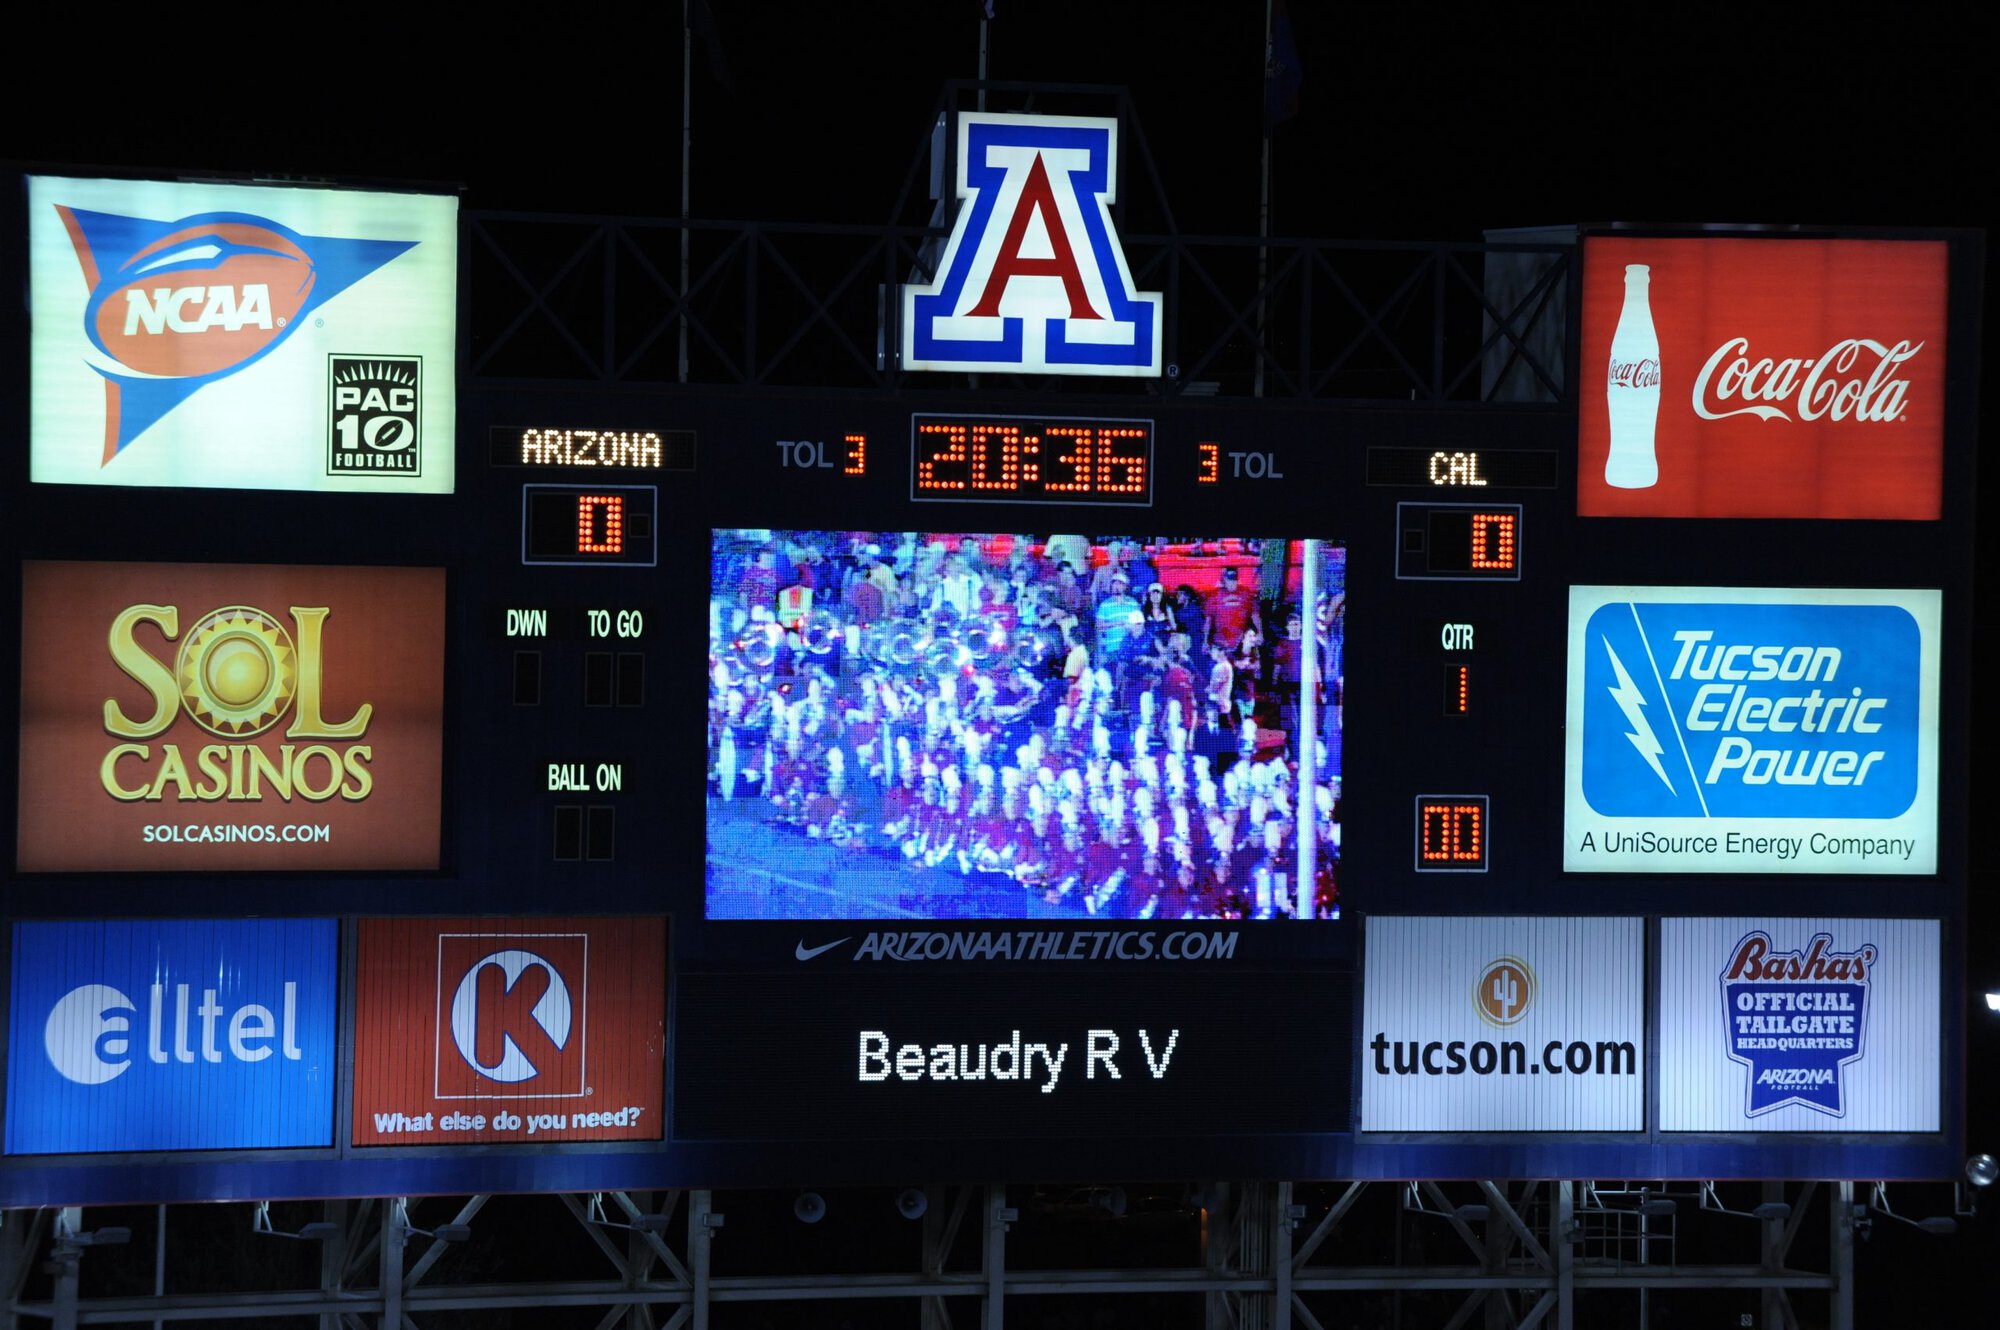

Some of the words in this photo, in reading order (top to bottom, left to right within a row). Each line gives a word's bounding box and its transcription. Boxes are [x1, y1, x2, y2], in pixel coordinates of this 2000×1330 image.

[905, 112, 1162, 377] A
[124, 284, 273, 335] NCAA
[335, 387, 414, 412] PAC
[336, 414, 414, 451] 10
[521, 429, 663, 468] ARIZONA
[336, 453, 412, 467] FOOTBALL
[777, 440, 833, 468] TOL
[844, 435, 865, 474] 3
[919, 424, 1146, 493] 20:36
[1198, 443, 1219, 482] 3
[1229, 452, 1283, 479] TOL
[1429, 452, 1487, 486] CAL
[577, 495, 623, 553] 0
[1472, 514, 1514, 569] 0
[506, 609, 547, 637] DWN
[588, 610, 610, 637] TO
[616, 611, 643, 638] GO
[1441, 623, 1474, 652] QTR
[103, 604, 374, 738] SOL
[1669, 630, 1842, 682] Tucson
[1686, 684, 1888, 733] Electric
[100, 744, 374, 803] CASINOS
[548, 764, 590, 791] BALL
[596, 764, 622, 790] ON
[1705, 736, 1885, 786] Power
[143, 824, 331, 844] SOLCASINOS.COM
[1580, 831, 1597, 853] A
[1604, 831, 1717, 854] UniSource
[1726, 833, 1803, 860] Energy
[1809, 833, 1915, 861] Company
[853, 931, 1238, 961] ARIZONAATHLETICS.COM
[1725, 937, 1873, 981] Bashas'
[1736, 992, 1855, 1011] OFFICIAL
[52, 982, 302, 1078] alltel
[1736, 1015, 1854, 1035] TAILGATE
[858, 1030, 1068, 1093] Beaudry
[1086, 1029, 1121, 1079] R
[1138, 1029, 1179, 1079] V
[1371, 1032, 1636, 1075] tucson.com
[1736, 1037, 1854, 1051] HEADQUARTERS
[1756, 1068, 1834, 1084] ARIZONA
[375, 1113, 434, 1134] What
[440, 1111, 486, 1133] else
[493, 1111, 521, 1132] do
[526, 1114, 566, 1135] you
[572, 1107, 641, 1129] need?
